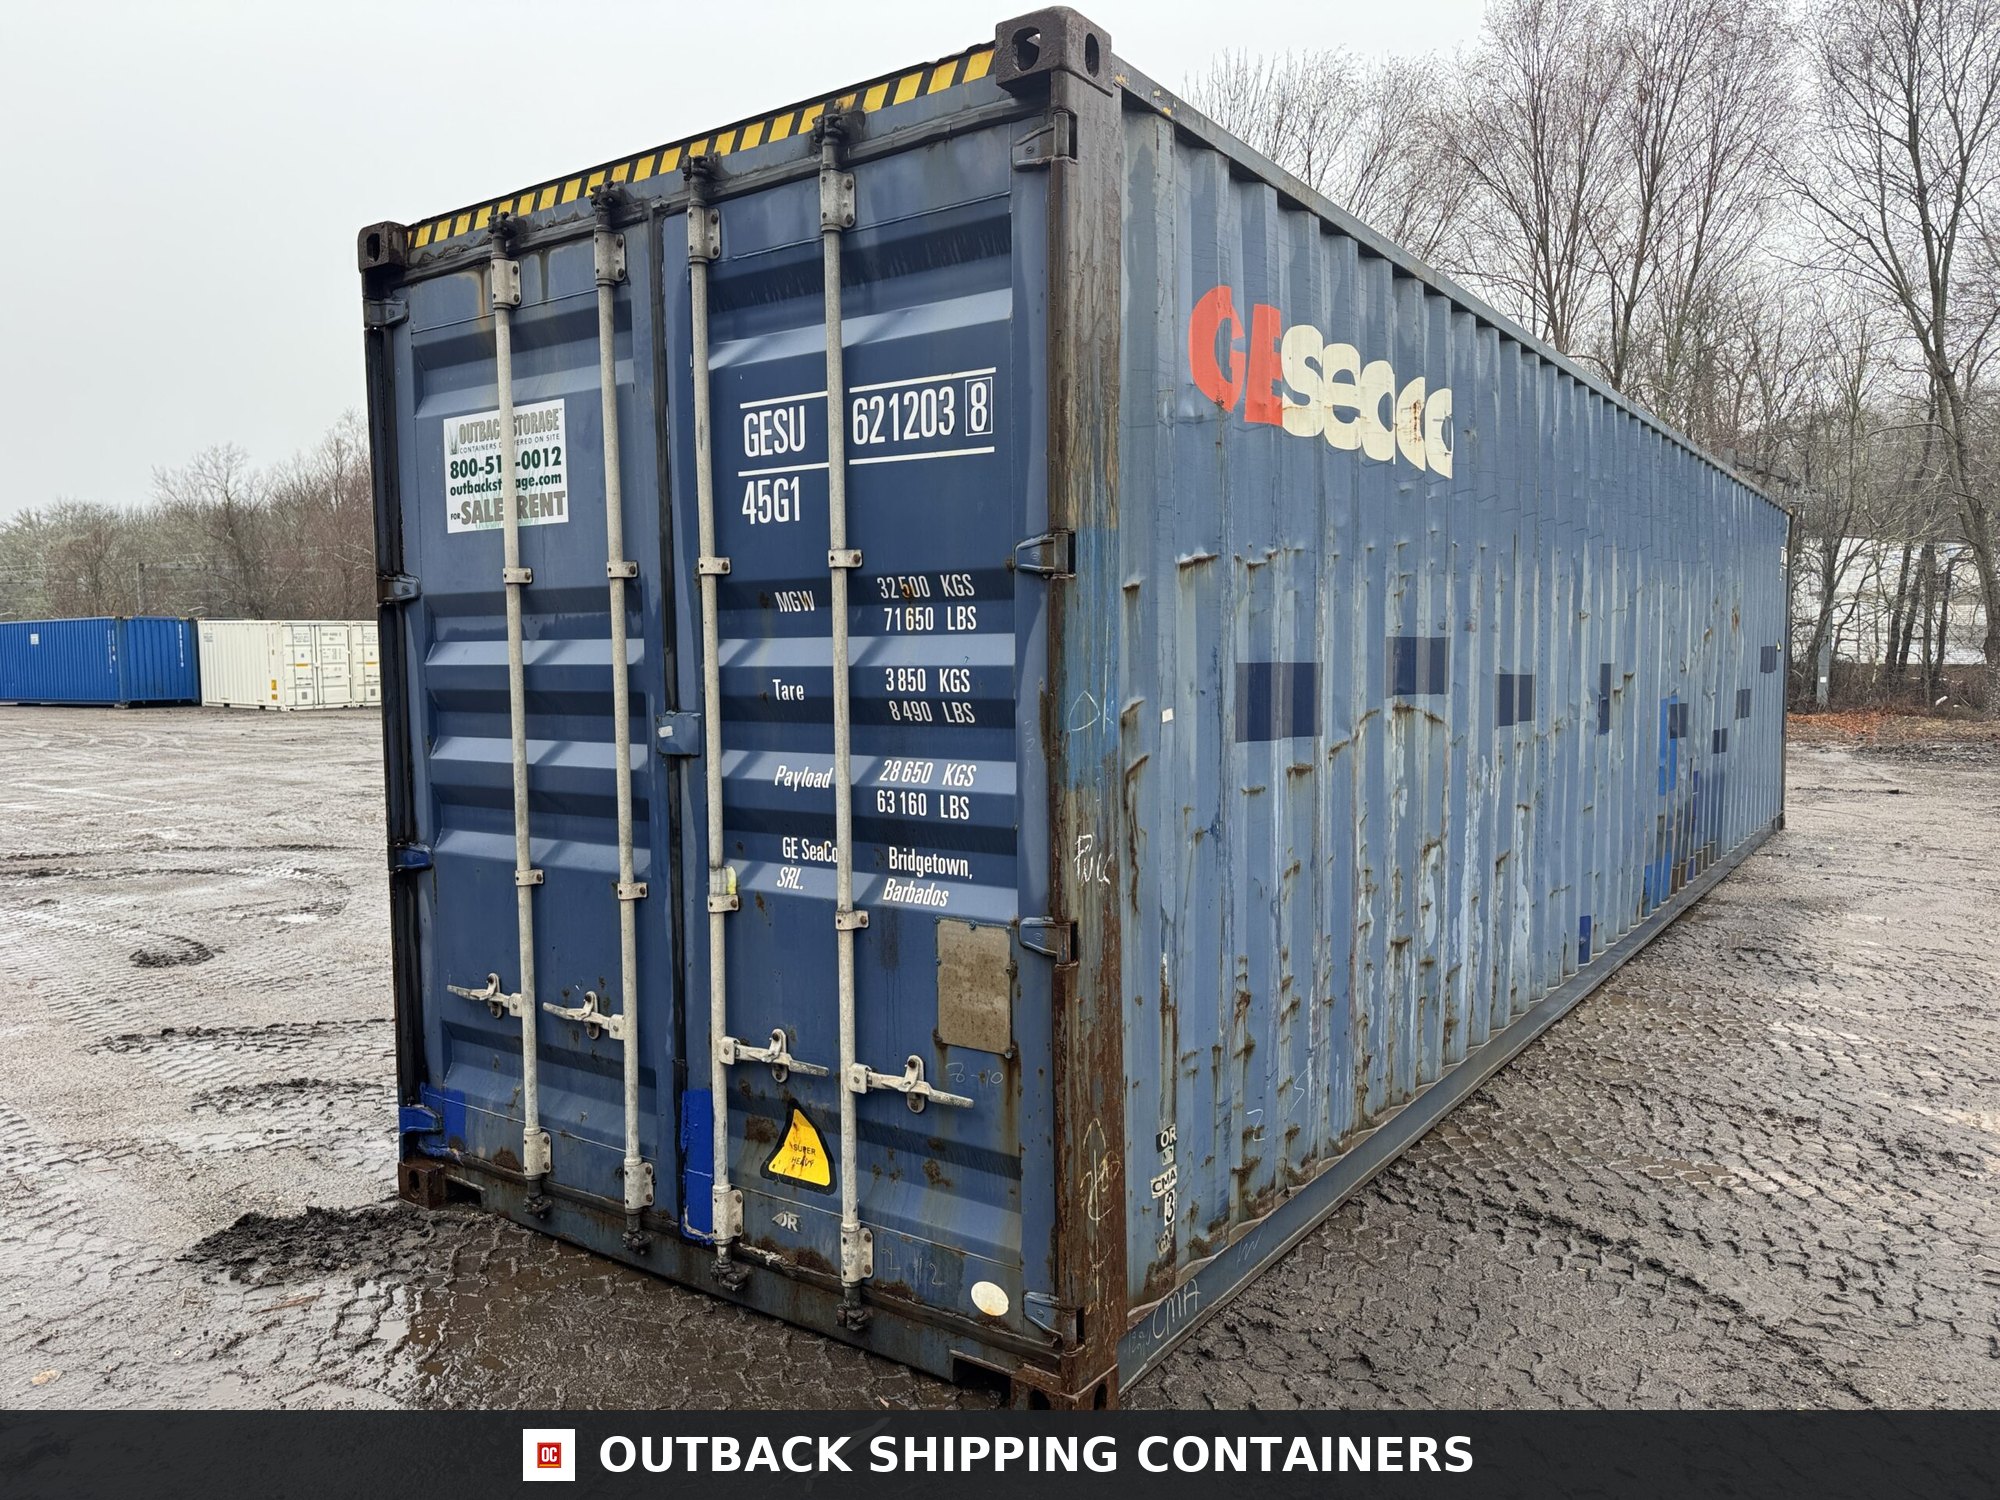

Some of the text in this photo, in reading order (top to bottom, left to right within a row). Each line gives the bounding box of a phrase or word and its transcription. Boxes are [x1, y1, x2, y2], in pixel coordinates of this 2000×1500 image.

[459, 418, 501, 445] OUTBAC
[743, 381, 988, 458] GESU 621203 8
[460, 443, 497, 454] CONTAINERS
[547, 433, 560, 441] SITE
[450, 446, 562, 479] 800-51-0012
[450, 473, 562, 496] outbackstage.com
[450, 491, 566, 525] FOR SALE RENT
[742, 476, 801, 525] 45G1
[775, 590, 815, 612] MGW
[940, 573, 975, 597] KGS
[947, 606, 977, 631] LBS
[772, 679, 805, 701] Tare
[939, 668, 971, 693] KGS
[942, 702, 976, 724] LBS
[774, 765, 834, 792] Payload
[942, 763, 977, 787] KGS
[940, 794, 970, 820] LBS
[782, 837, 838, 863] GE SeaCo
[888, 846, 973, 880] Bridgetown,
[776, 867, 804, 890] SRL.
[882, 878, 949, 907] Barbados
[793, 1143, 816, 1155] SUPER
